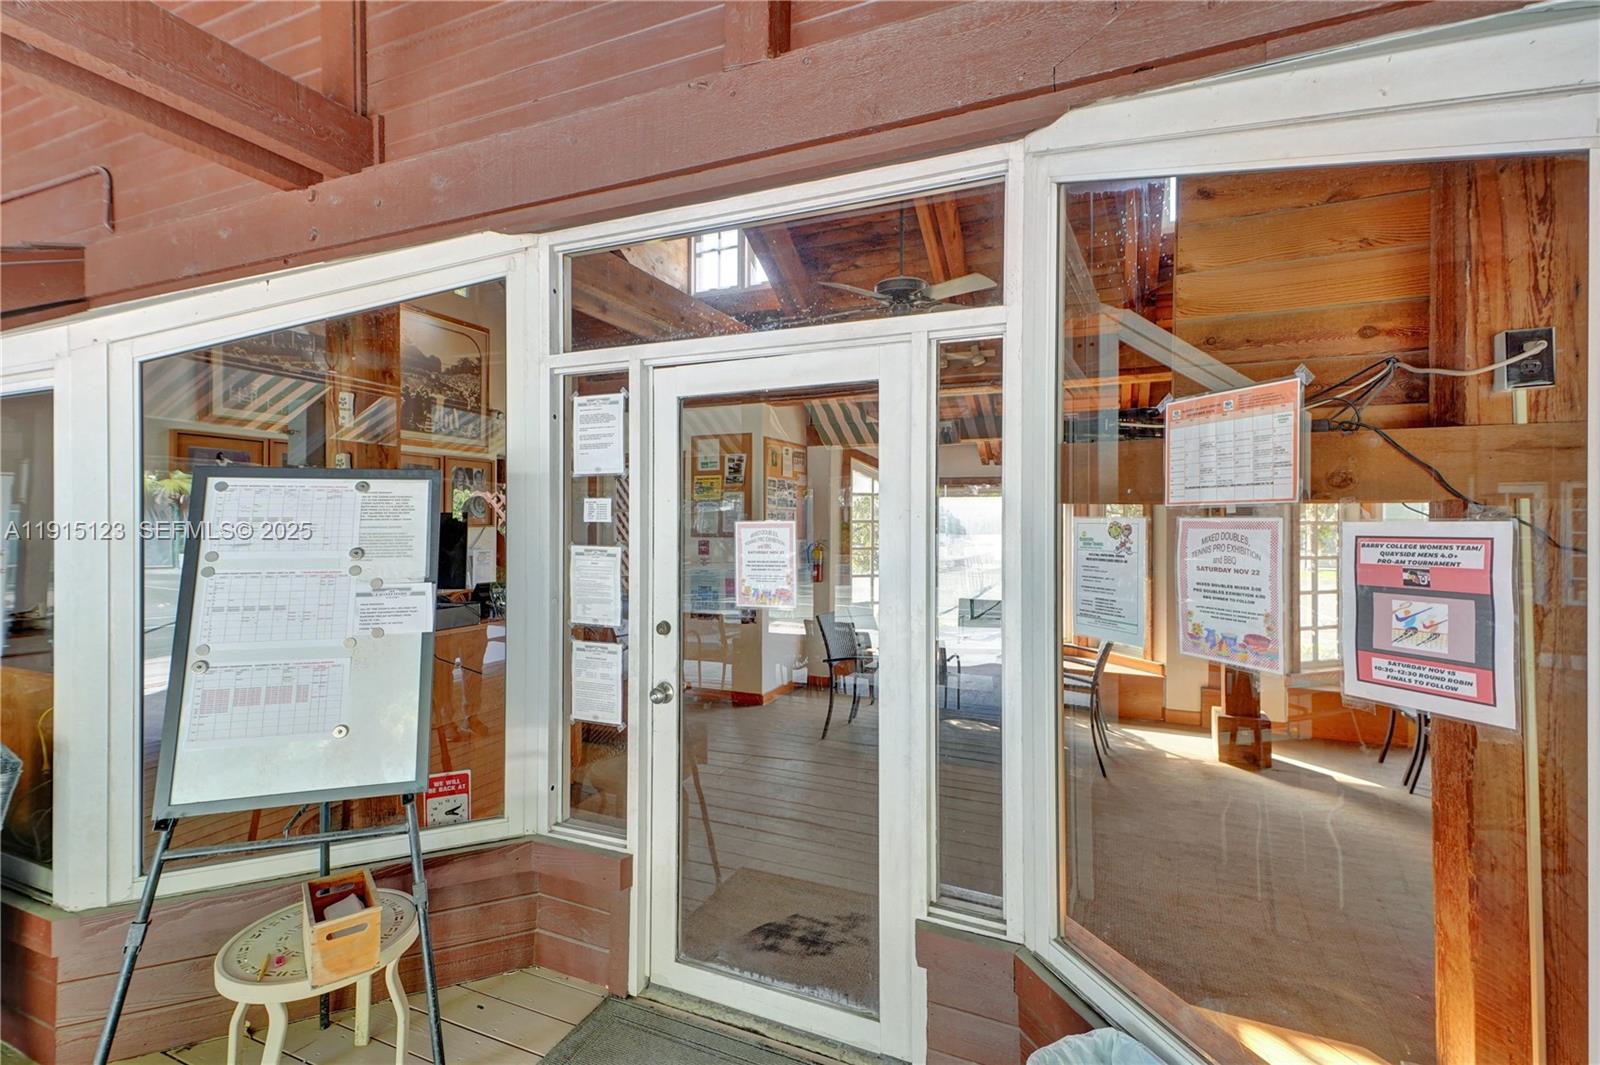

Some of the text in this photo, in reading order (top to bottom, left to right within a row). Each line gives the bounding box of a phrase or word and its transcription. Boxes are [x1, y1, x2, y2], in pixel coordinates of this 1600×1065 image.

[1202, 532, 1250, 547] MIXED DOUBLES,
[1192, 544, 1261, 561] TENNIS PRO EXHIBITION
[1224, 556, 1236, 565] BBQ
[1388, 661, 1427, 671] SATURDAY
[1374, 666, 1473, 687] 10:30-12:30 ROUND ROBIN
[1387, 675, 1412, 683] FINALS
[1426, 681, 1459, 692] FOLLOW
